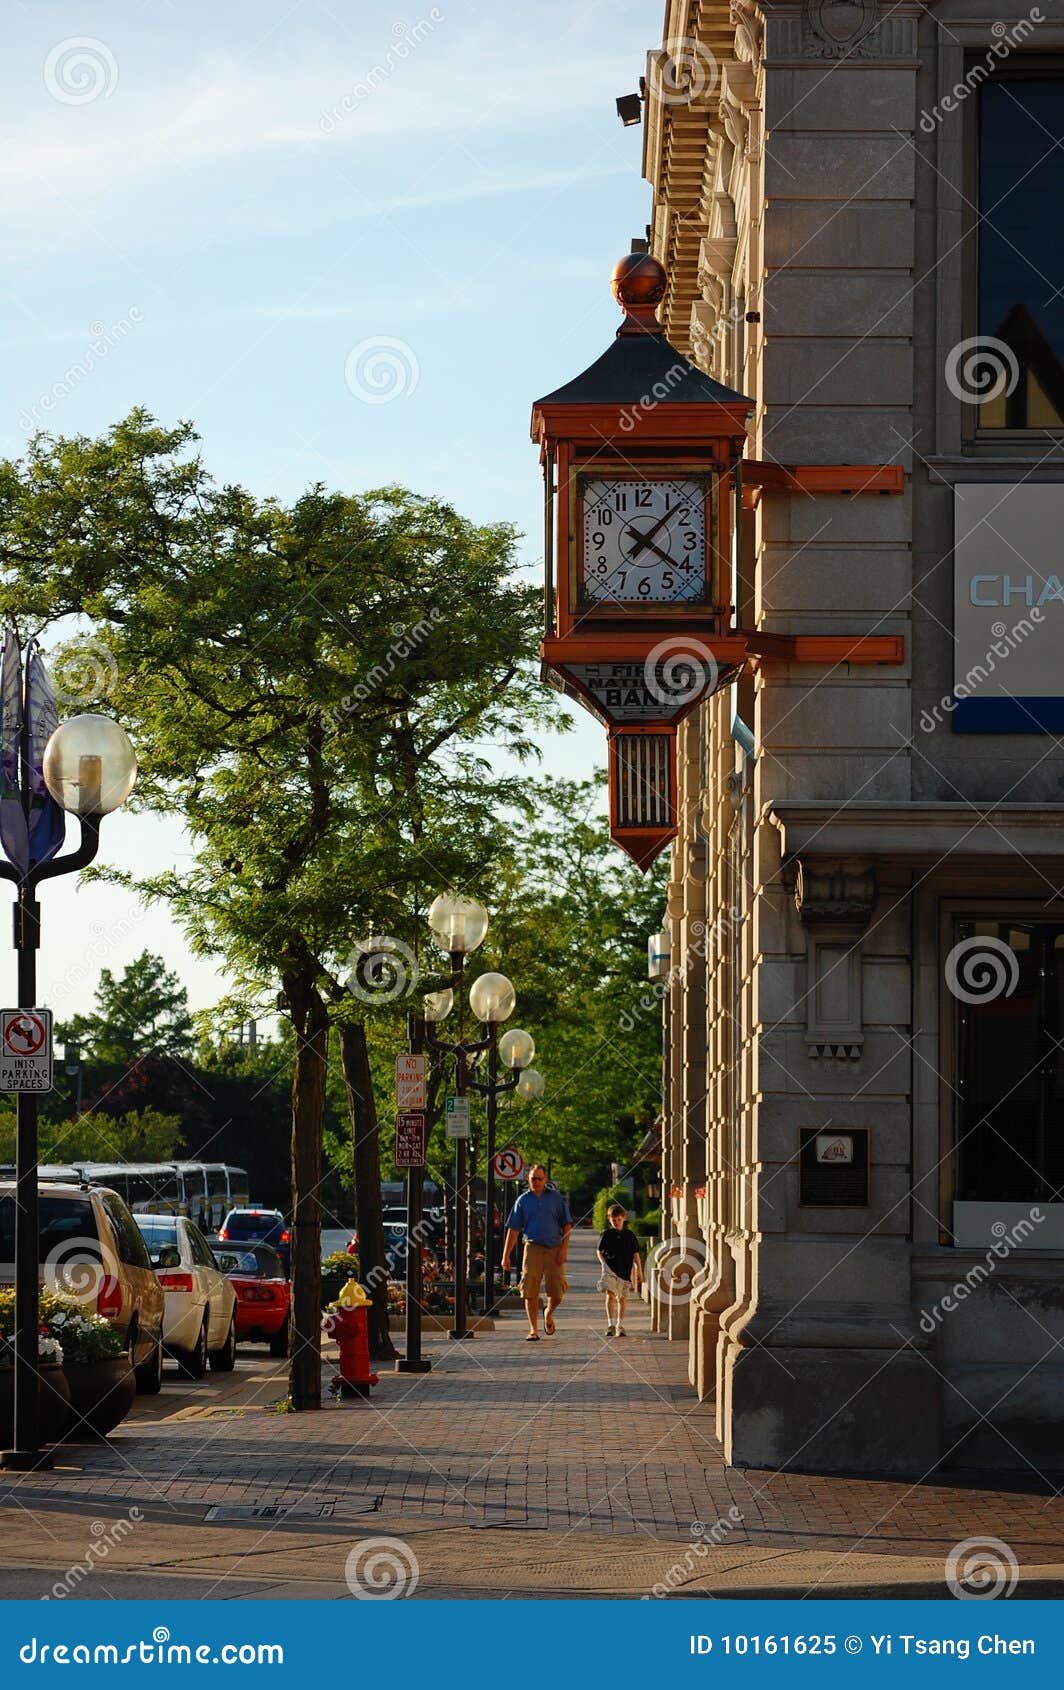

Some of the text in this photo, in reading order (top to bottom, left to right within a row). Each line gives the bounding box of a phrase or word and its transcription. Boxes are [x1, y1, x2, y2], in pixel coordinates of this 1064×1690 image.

[615, 493, 627, 511] 11
[635, 488, 653, 507] 12
[665, 493, 670, 511] 1
[597, 508, 612, 526] 10
[678, 508, 691, 526] 2
[592, 532, 605, 550] 9
[683, 532, 697, 551] 3
[597, 556, 608, 574] 8
[678, 555, 694, 574] 4
[617, 571, 628, 590] 7
[637, 577, 651, 595] 6
[661, 571, 674, 590] 5
[969, 574, 1064, 607] CHA
[15, 1060, 35, 1068] INTO
[405, 1059, 417, 1069] NO
[2, 1070, 47, 1079] PARKING
[397, 1072, 425, 1081] PARKING
[7, 1080, 43, 1088] SPACES
